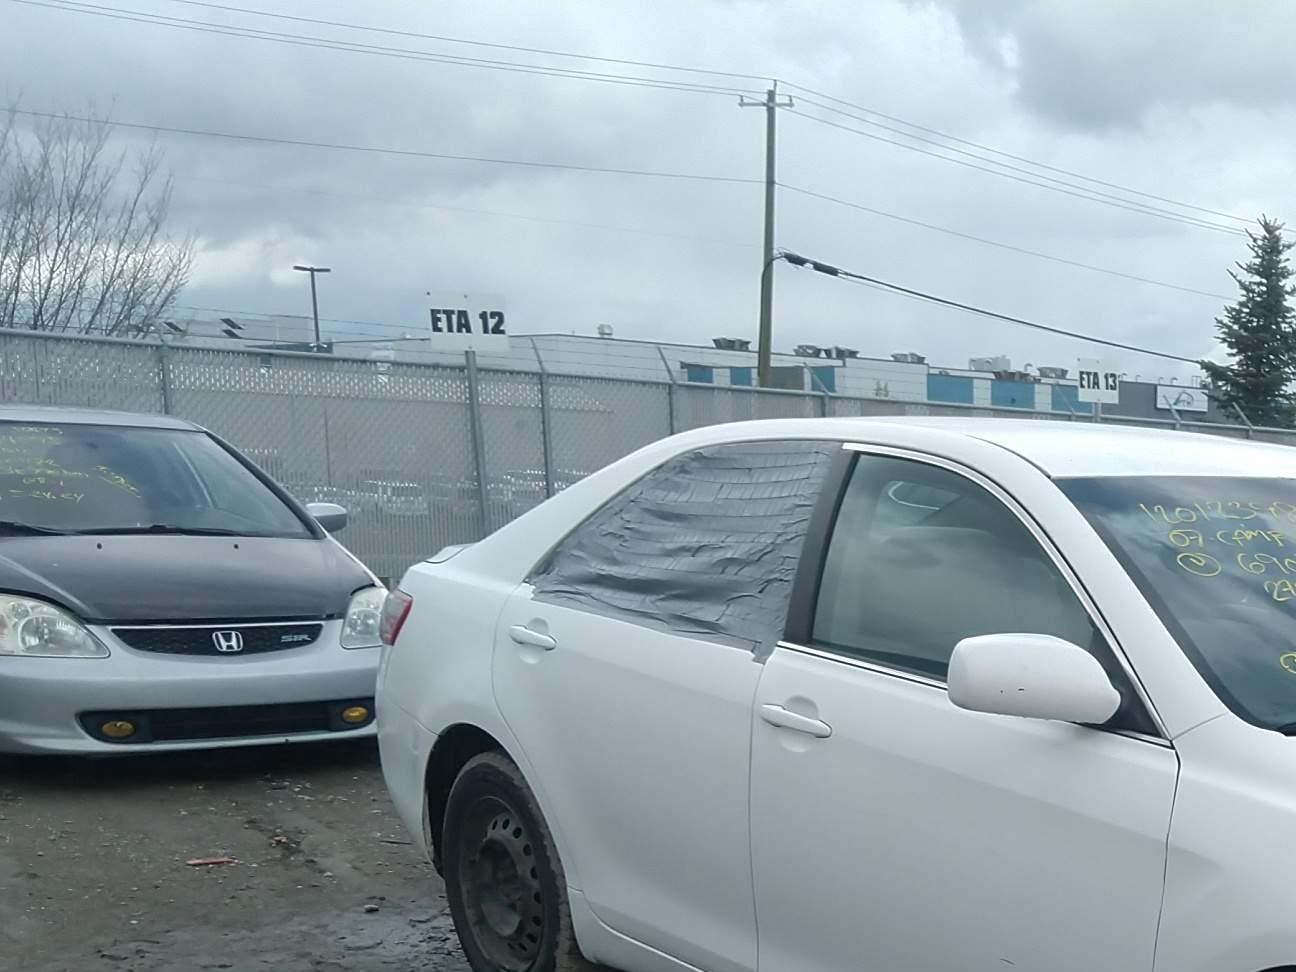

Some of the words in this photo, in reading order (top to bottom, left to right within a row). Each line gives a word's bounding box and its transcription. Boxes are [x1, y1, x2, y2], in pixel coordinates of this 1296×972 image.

[430, 308, 472, 334] ETA
[479, 310, 506, 335] 12
[1079, 370, 1100, 390] ETA
[1104, 372, 1118, 391] 13
